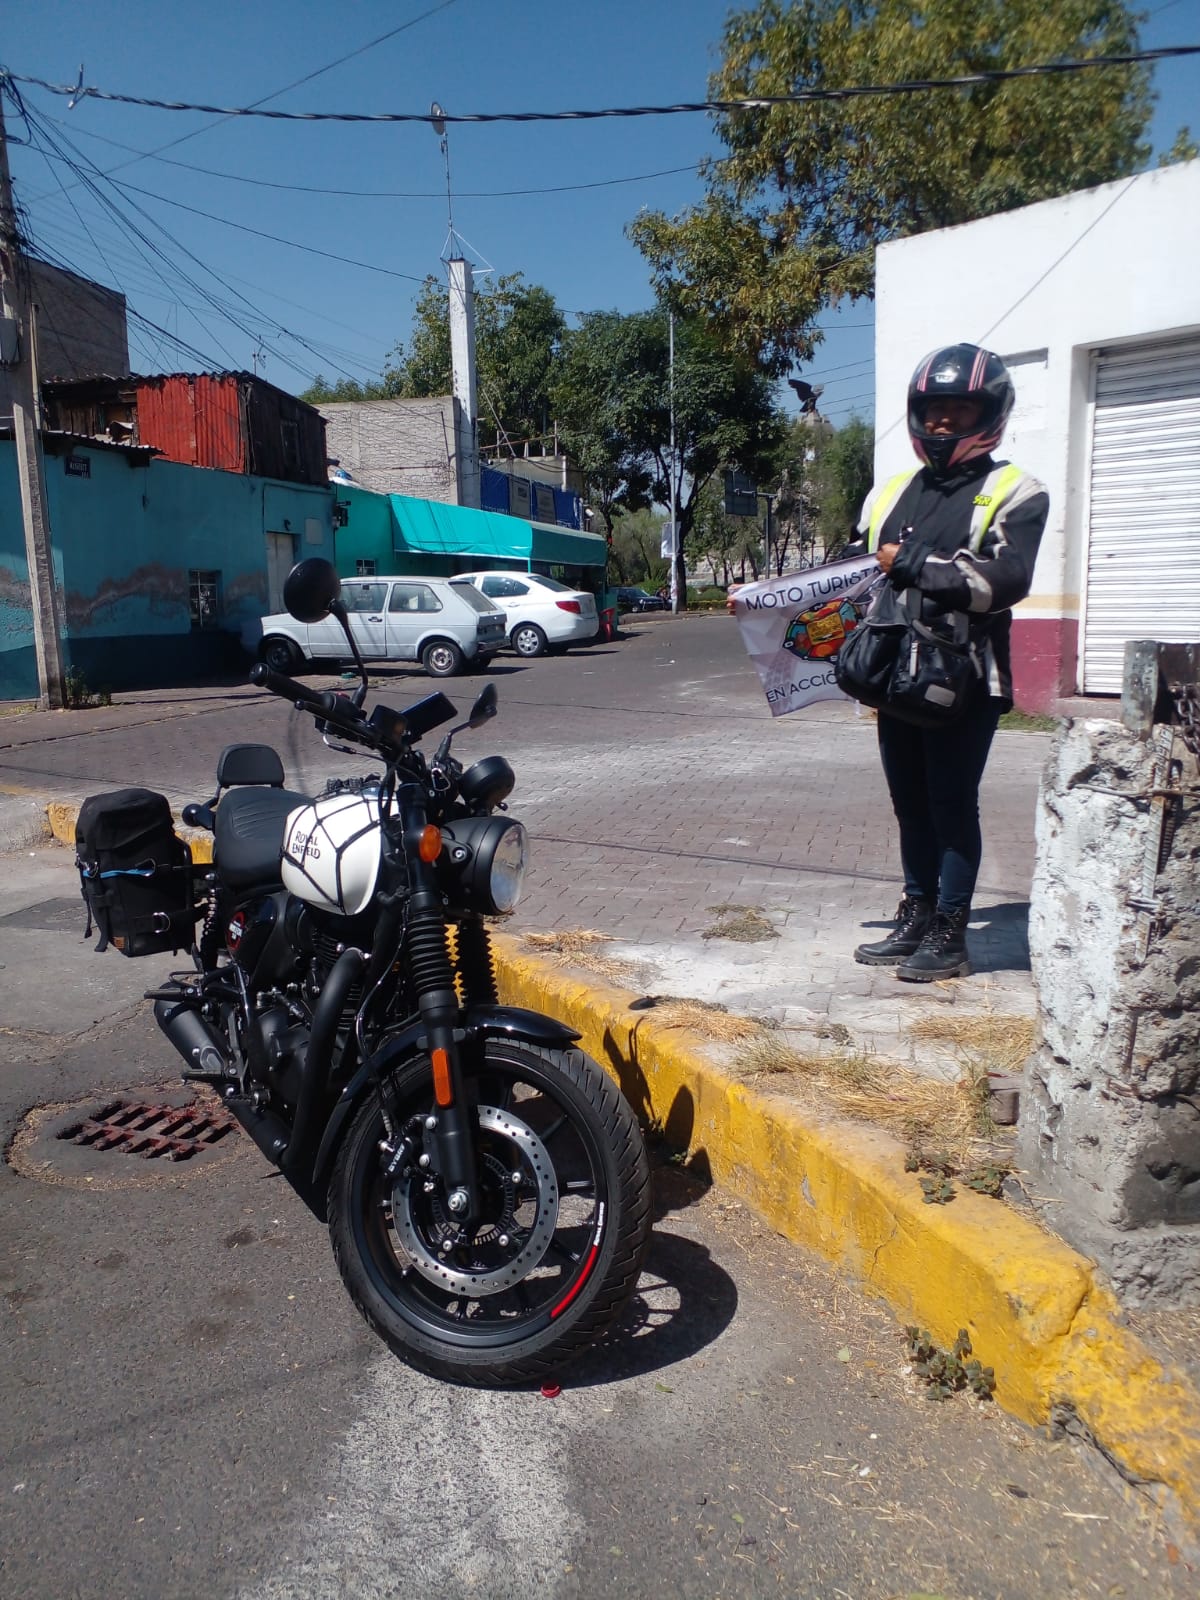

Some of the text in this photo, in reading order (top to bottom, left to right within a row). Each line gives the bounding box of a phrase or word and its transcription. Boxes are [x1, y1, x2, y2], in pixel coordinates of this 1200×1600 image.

[745, 587, 803, 611] MOTO
[766, 670, 837, 703] EN ACCIÓ
[292, 843, 321, 859] ENFELD
